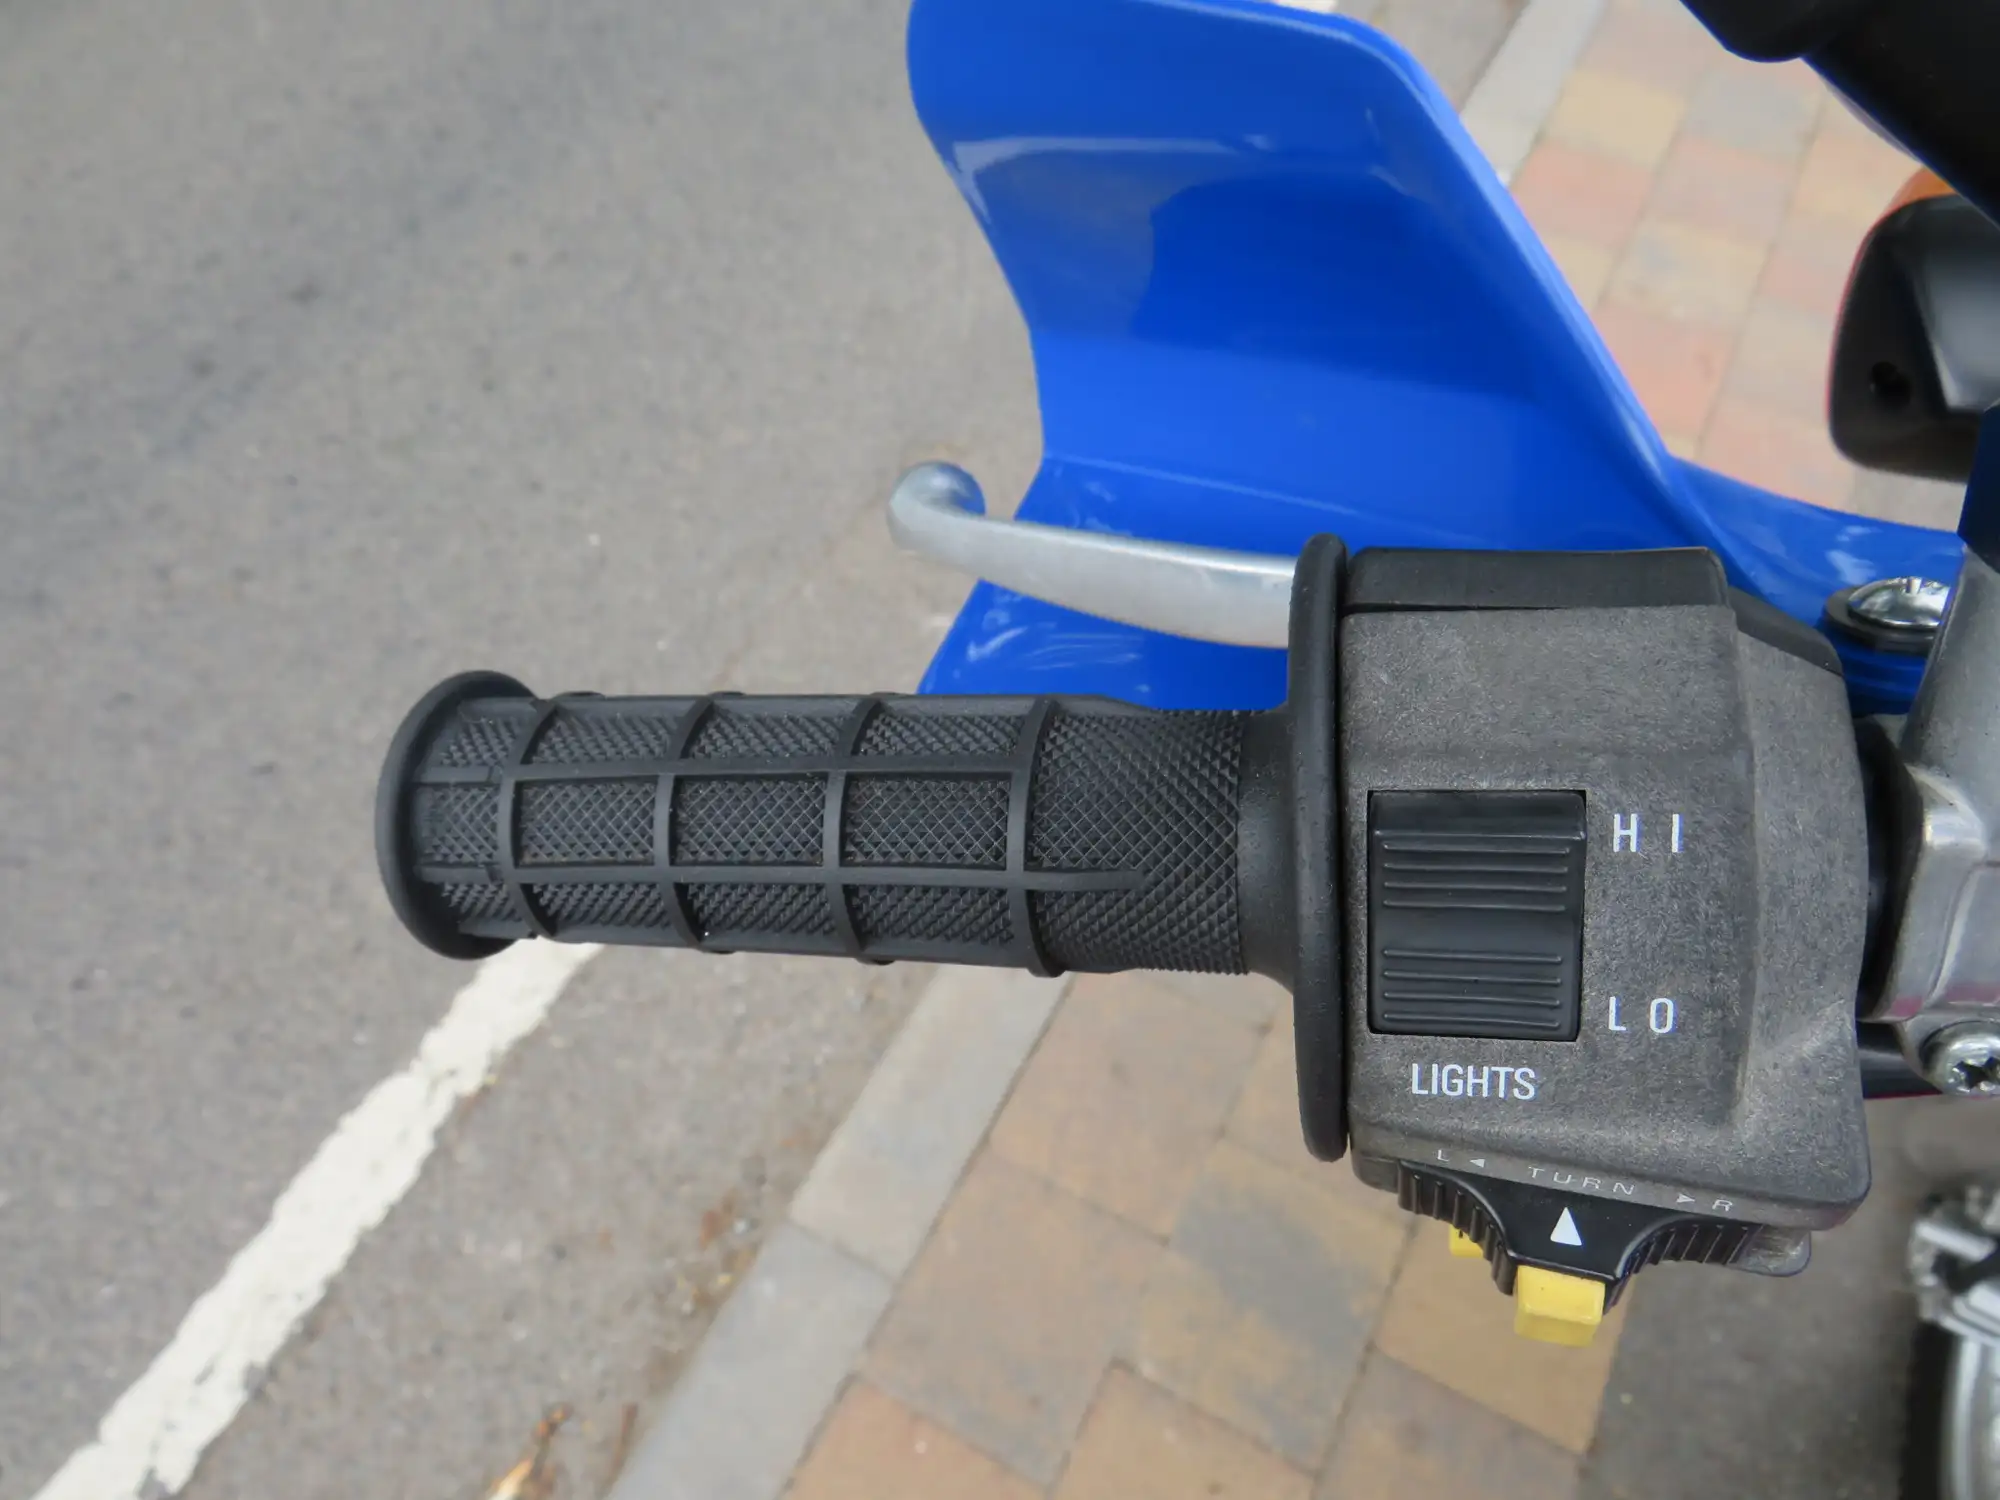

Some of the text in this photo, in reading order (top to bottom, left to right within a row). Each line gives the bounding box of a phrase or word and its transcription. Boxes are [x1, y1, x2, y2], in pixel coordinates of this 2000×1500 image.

[1612, 813, 1683, 853] HI
[1608, 996, 1677, 1034] LO
[1411, 1063, 1536, 1101] LIGHTS
[1436, 1149, 1734, 1213] L TURN R
